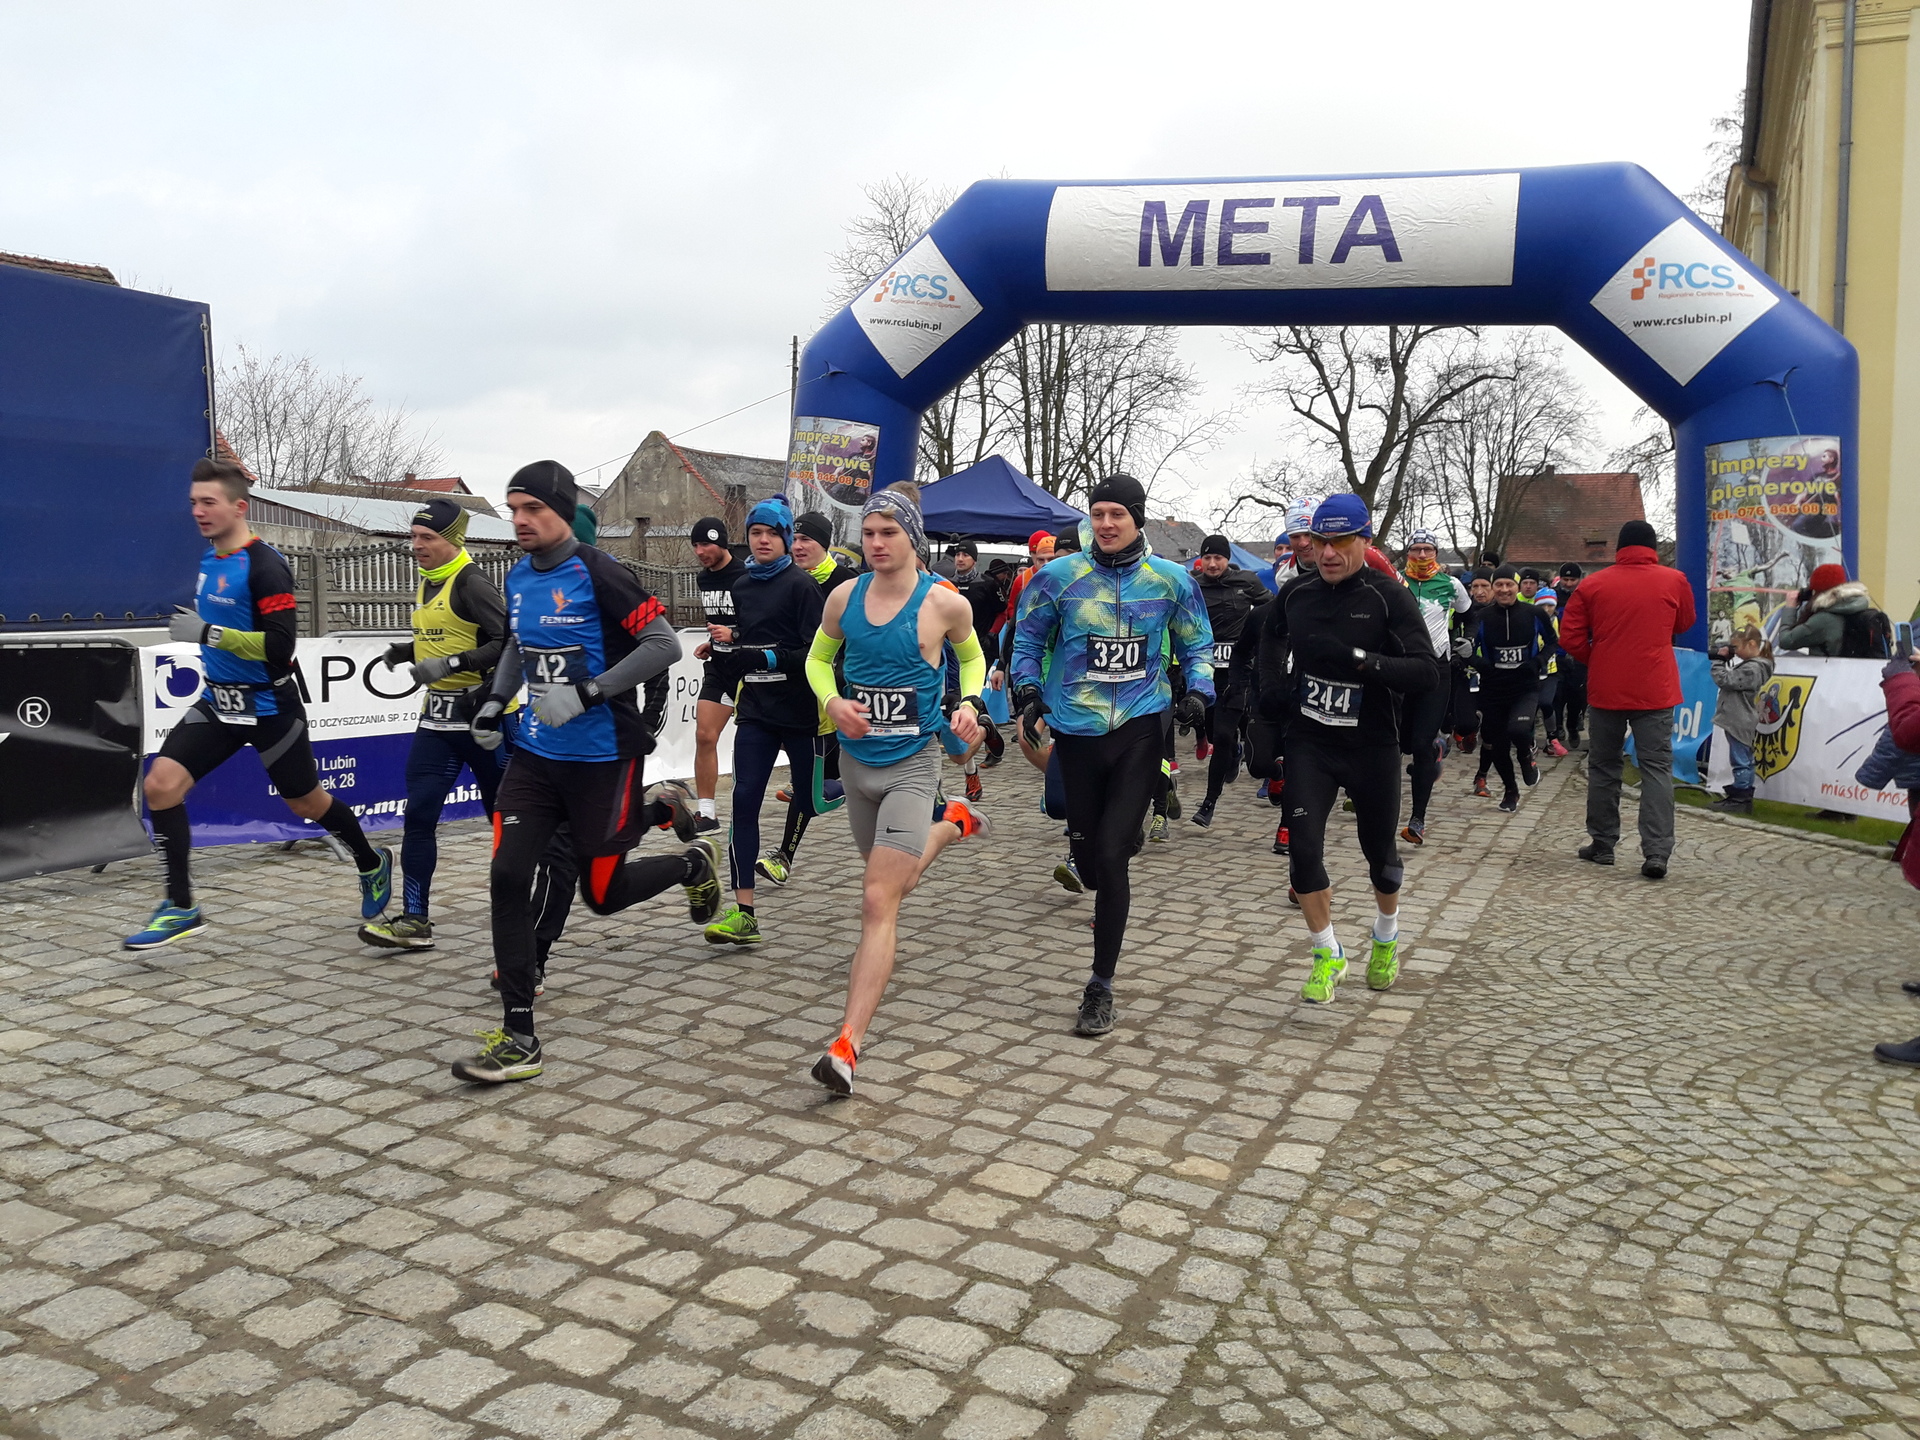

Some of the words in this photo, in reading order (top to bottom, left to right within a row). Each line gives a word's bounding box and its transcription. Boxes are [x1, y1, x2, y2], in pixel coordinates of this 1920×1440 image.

[1138, 195, 1403, 267] META
[869, 317, 942, 331] www.rcslubin.pl
[1633, 312, 1732, 328] www.rcslubin.pl
[794, 429, 851, 449] Imprezy
[790, 450, 871, 472] plenerowe
[1711, 454, 1808, 475] Imprezy
[799, 471, 814, 480] 076
[817, 472, 836, 482] 846
[838, 475, 853, 485] 08
[854, 478, 869, 488] 28
[1711, 481, 1837, 504] plenerowe
[1711, 510, 1733, 521] tel.
[1737, 506, 1765, 518] 076
[1770, 503, 1798, 515] 846
[1802, 503, 1820, 514] 08
[1823, 503, 1838, 515] 28
[539, 616, 585, 624] FENIKS
[1094, 642, 1139, 667] 320
[1500, 649, 1522, 662] 331
[536, 654, 569, 683] 42
[213, 687, 245, 711] 193
[429, 695, 455, 719] 127
[857, 691, 907, 720] 202
[1307, 681, 1351, 713] 244
[320, 713, 385, 728] OCZYSZCZANIA
[388, 714, 400, 722] SP.
[403, 712, 409, 722] Z
[321, 755, 356, 771] Lubin
[339, 772, 355, 788] 28
[1821, 780, 1868, 801] miasto
